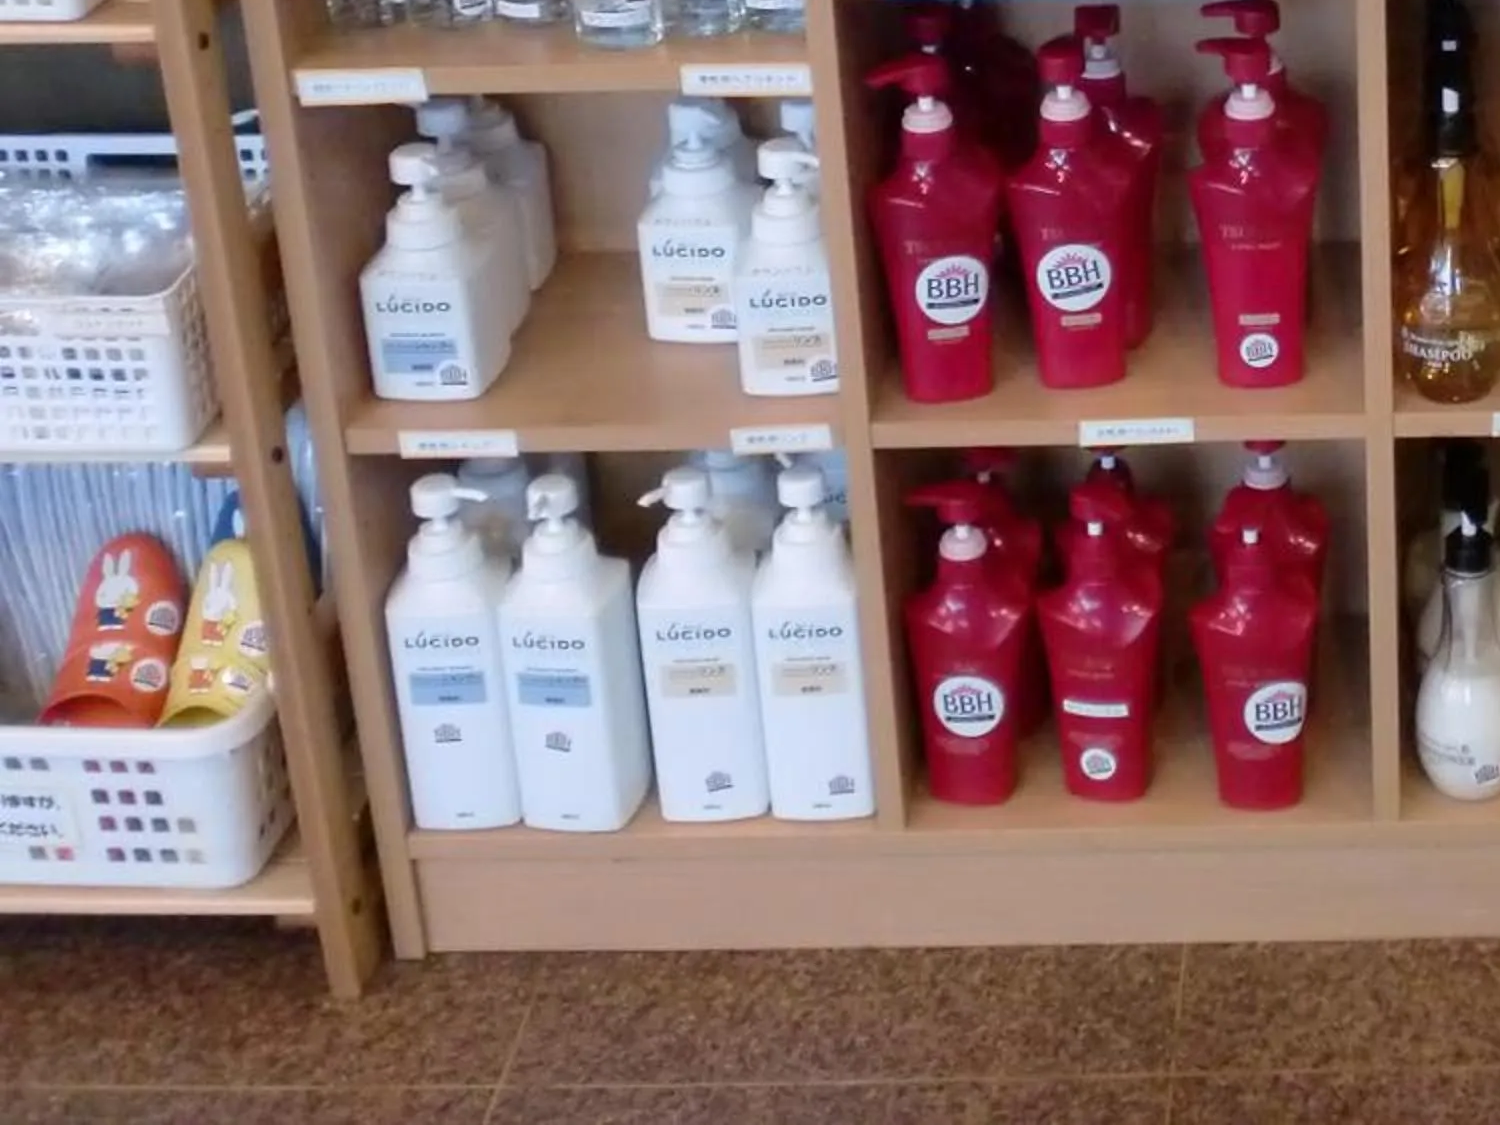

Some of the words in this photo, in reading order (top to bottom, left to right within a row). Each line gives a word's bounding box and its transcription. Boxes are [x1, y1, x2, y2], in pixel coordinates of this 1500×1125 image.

[926, 274, 980, 300] BBH
[1046, 259, 1103, 291] BBH
[943, 692, 994, 716] BBH
[1255, 697, 1303, 723] BBH
